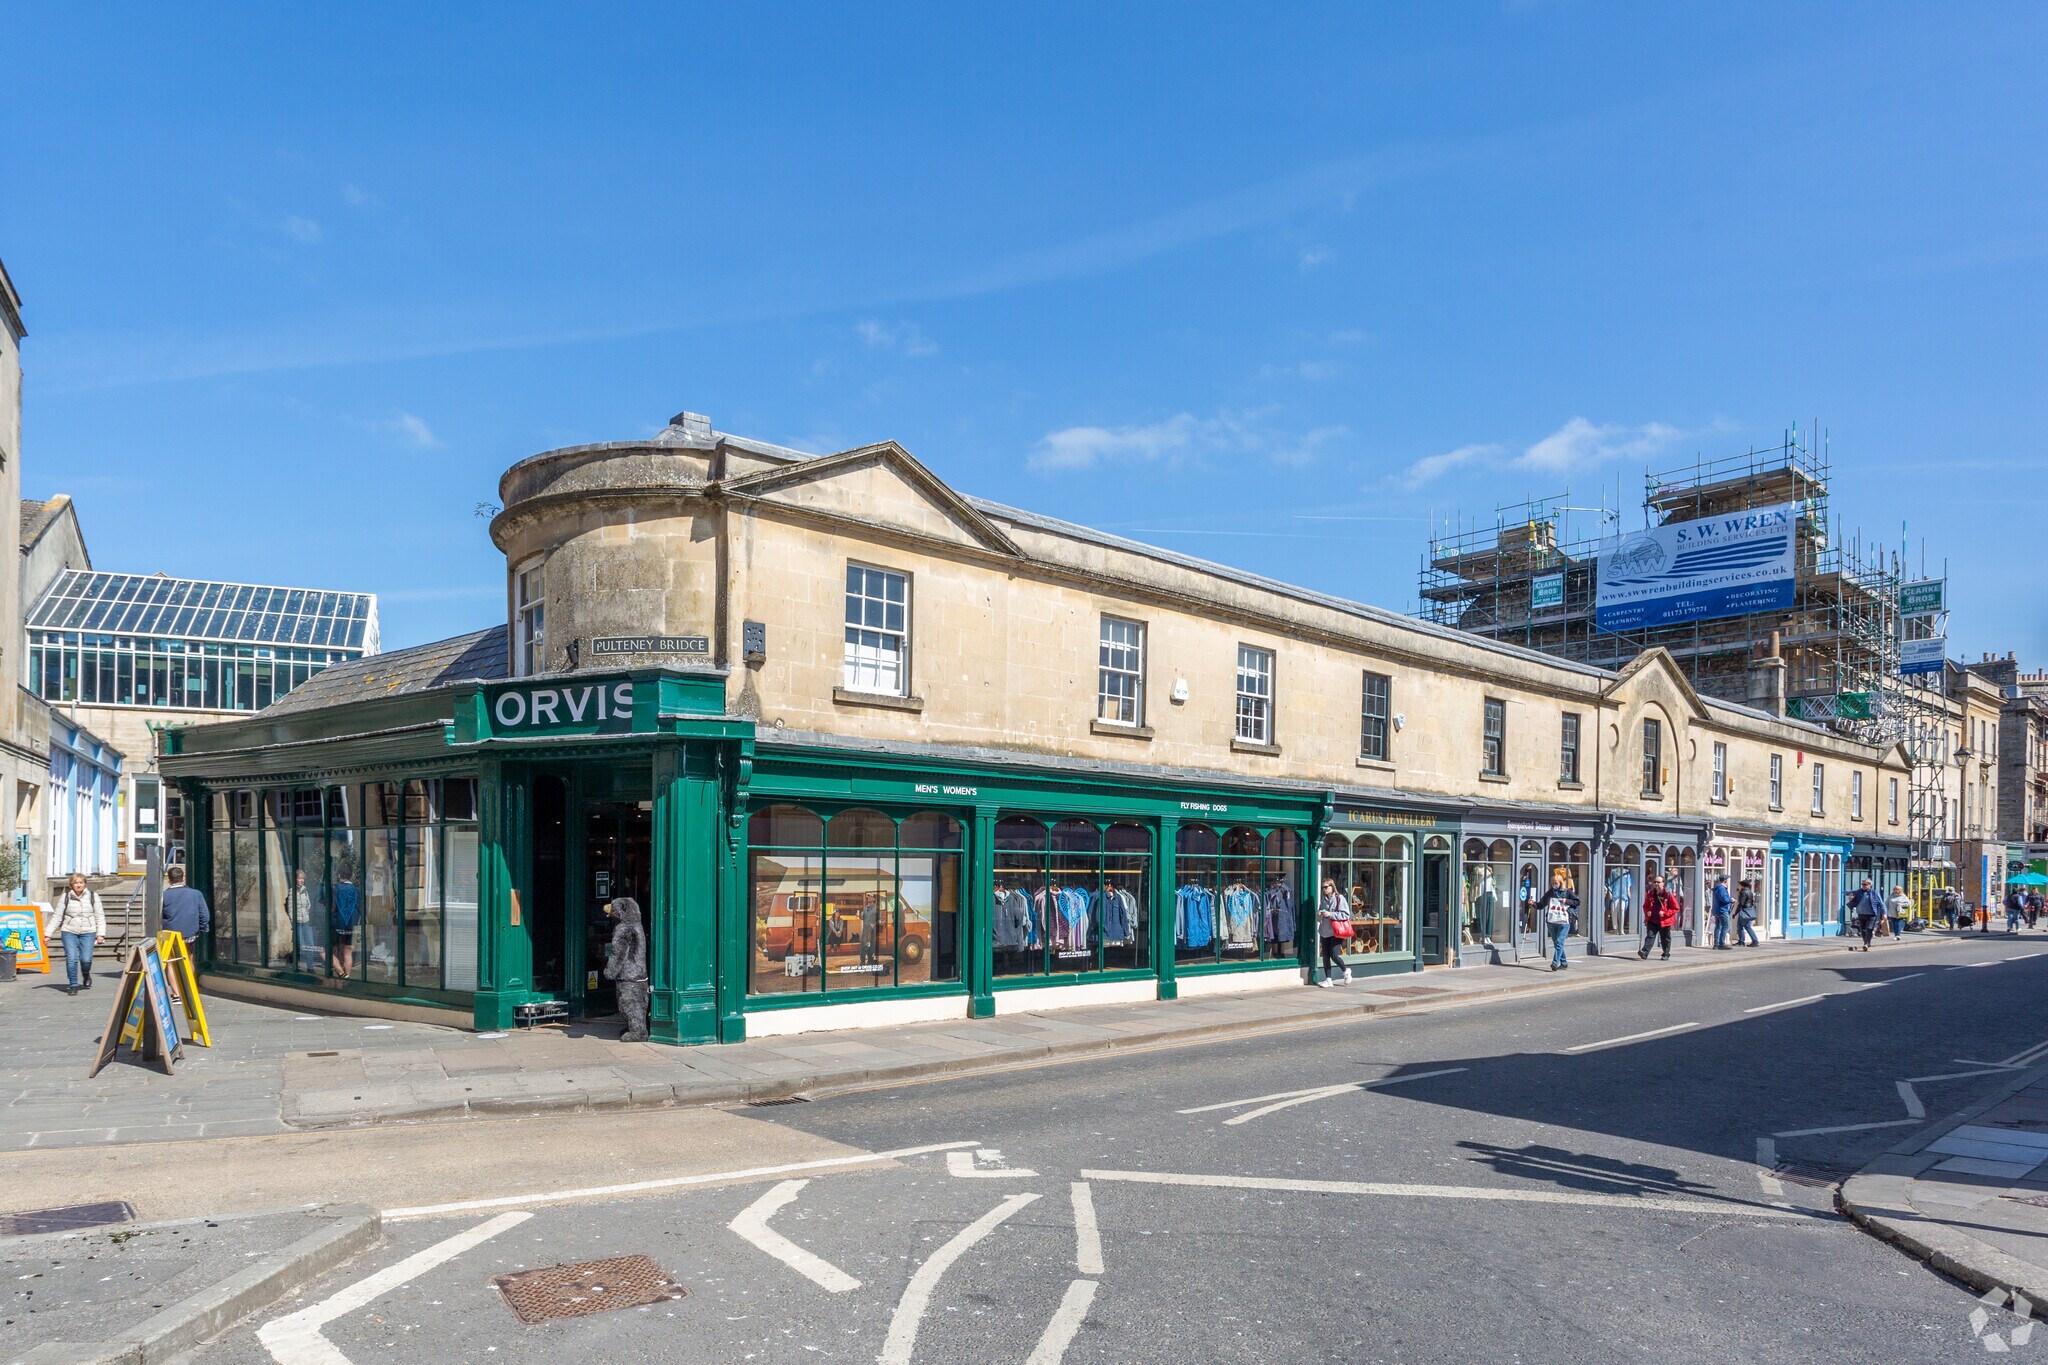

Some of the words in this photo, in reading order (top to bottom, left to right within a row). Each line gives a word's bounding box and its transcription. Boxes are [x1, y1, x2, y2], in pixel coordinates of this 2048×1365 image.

[1677, 529, 1692, 543] S.
[1697, 523, 1719, 538] W.
[1725, 510, 1788, 533] WREN
[1677, 538, 1720, 551] BUILDING
[1722, 530, 1766, 546] SERVICES
[1770, 525, 1788, 535] LTD
[1535, 580, 1561, 589] CLARKE
[1602, 565, 1787, 601] www.swwrenbuildingservices.co.uk
[1731, 588, 1779, 599] DECORATING
[1903, 585, 1940, 596] CLARKE
[1731, 597, 1777, 608] PLASTERING
[1907, 594, 1935, 604] BROS
[1607, 607, 1645, 618] CARPENTRY
[1663, 609, 1684, 618] 01173
[1607, 616, 1642, 626] PLUMBING
[596, 640, 654, 652] PULTENEY
[495, 683, 633, 726] ORVIS
[915, 784, 939, 794] MEN'S
[943, 786, 977, 796] WOMEN'S
[1180, 801, 1190, 810] FLY
[1190, 802, 1210, 811] FISHING
[1213, 804, 1228, 812] DOGS
[1348, 810, 1383, 824] ICARUS
[1385, 812, 1438, 827] JEWELLERY
